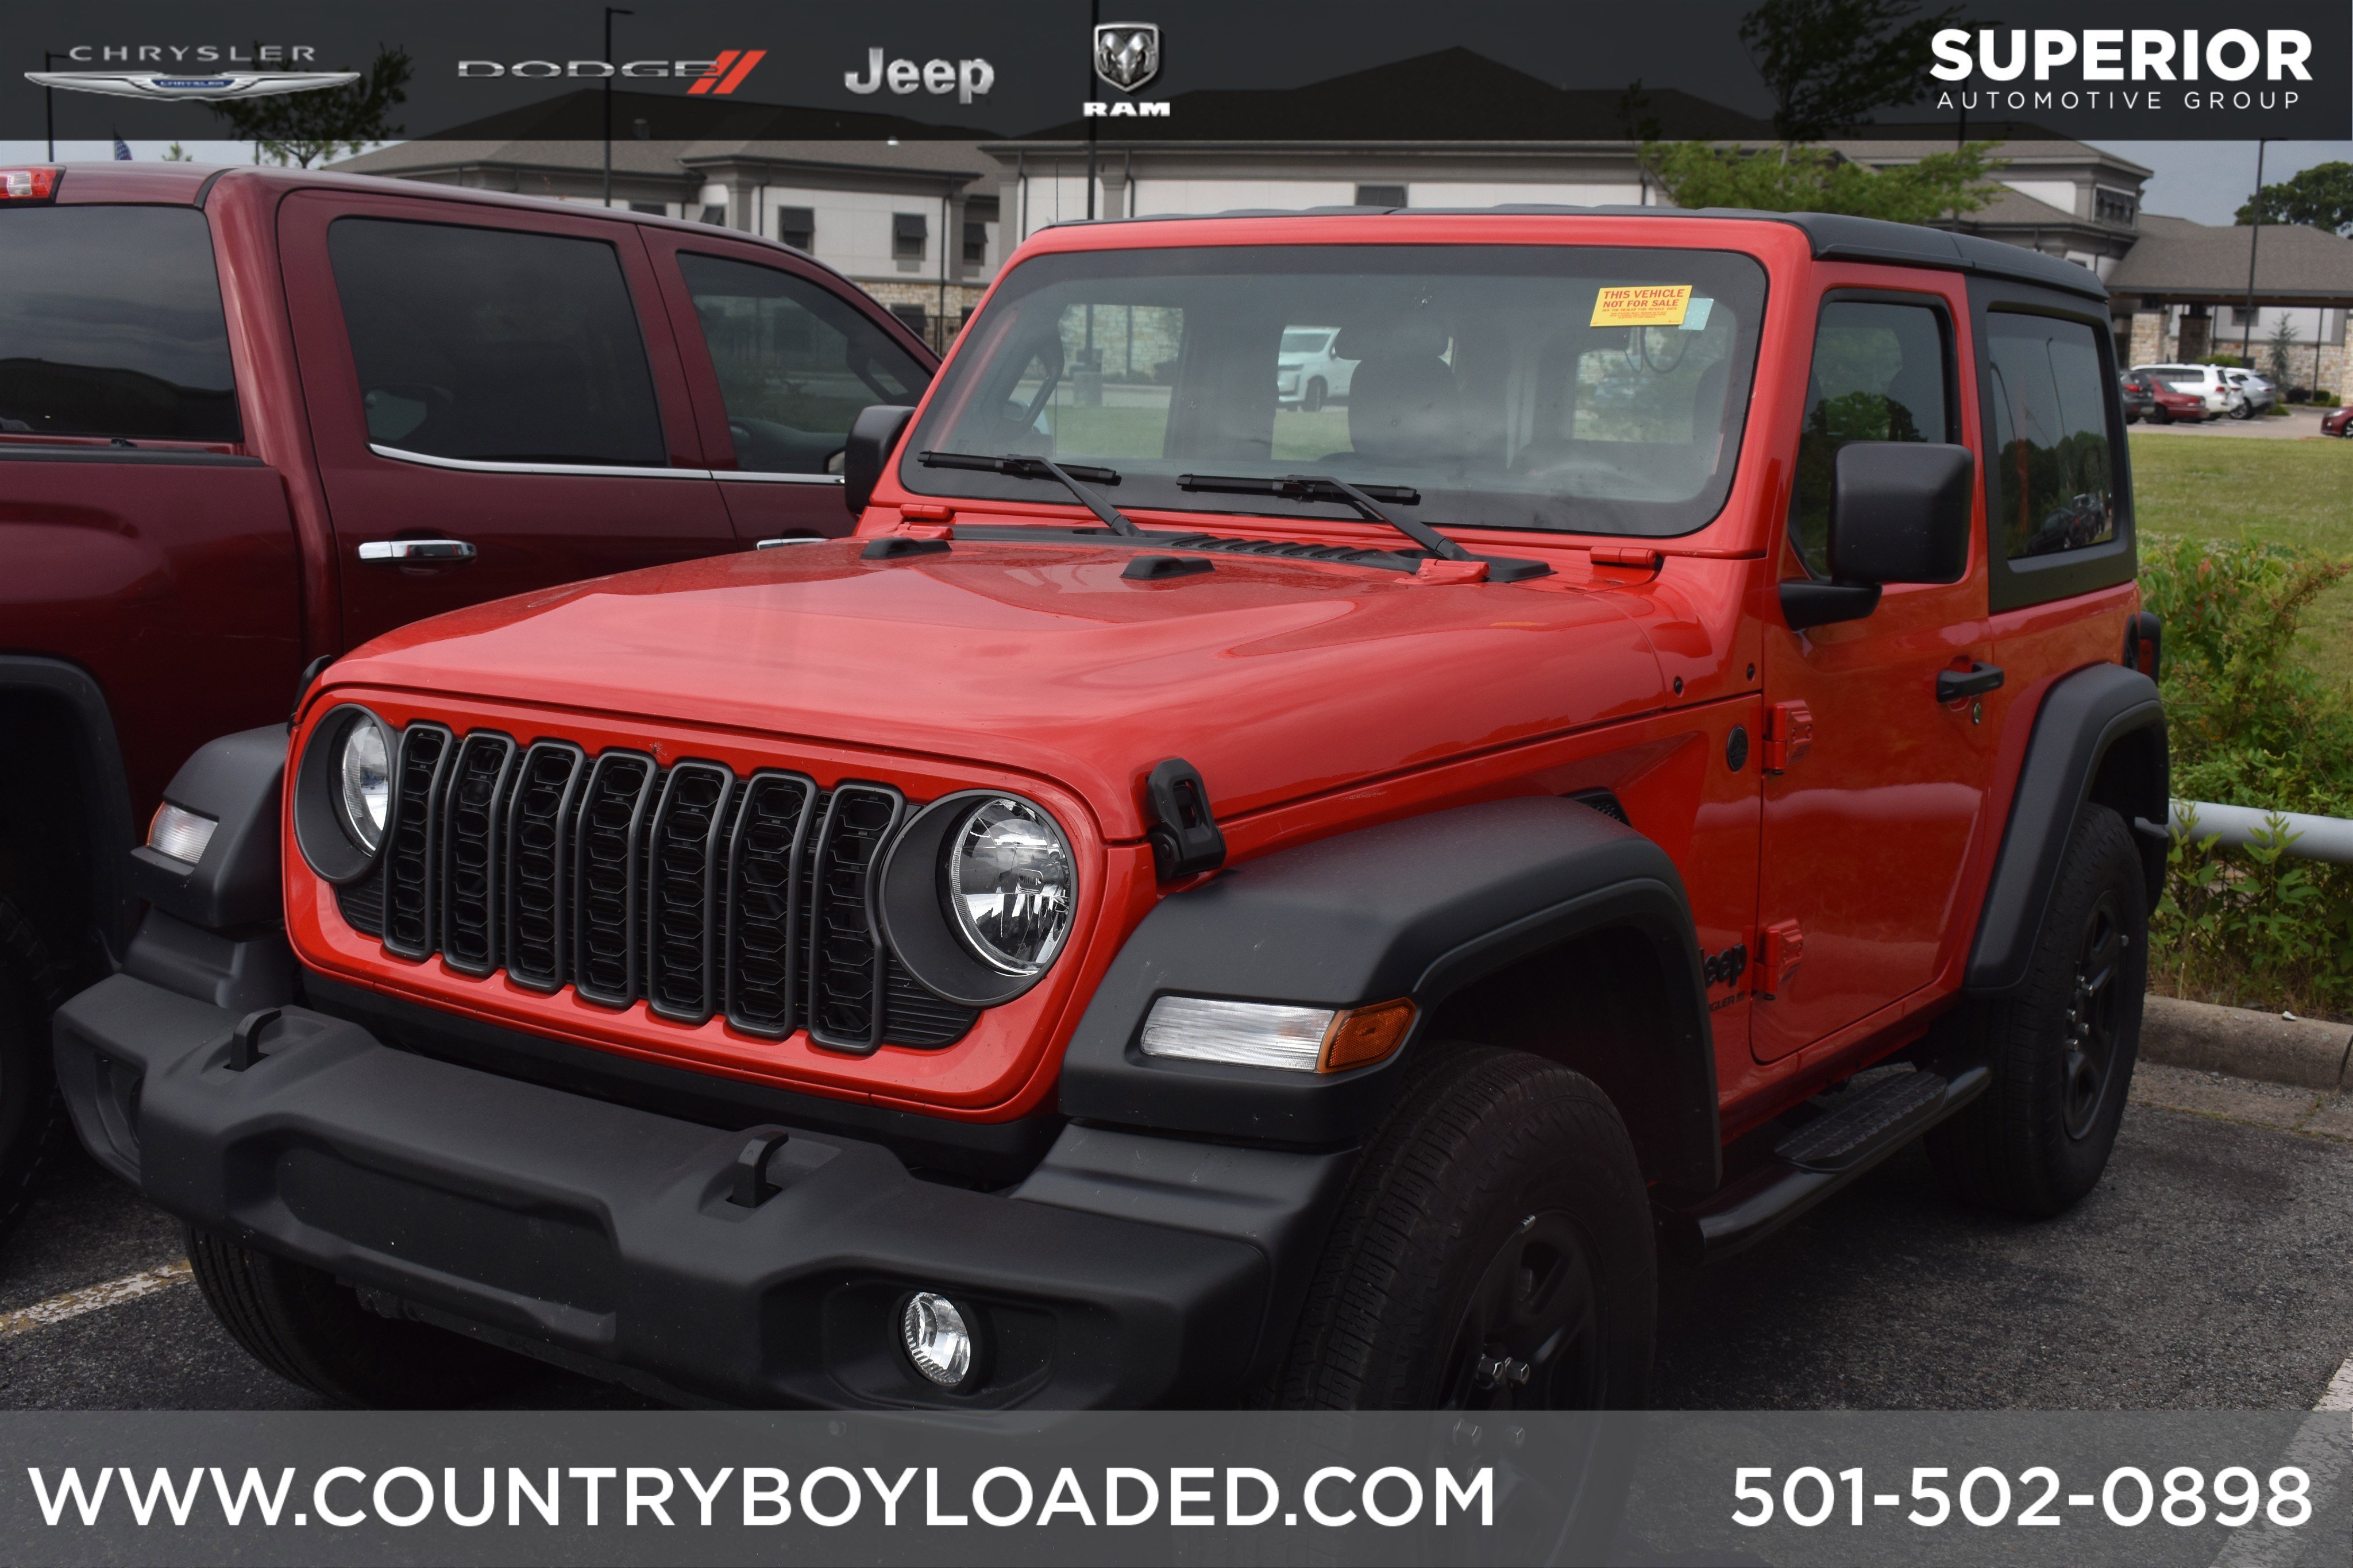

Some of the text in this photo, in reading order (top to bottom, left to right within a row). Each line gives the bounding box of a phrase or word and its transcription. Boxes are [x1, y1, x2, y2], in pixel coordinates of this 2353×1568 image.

[1604, 289, 1685, 299] THIS VEHICLE
[1699, 944, 1747, 987] eep
